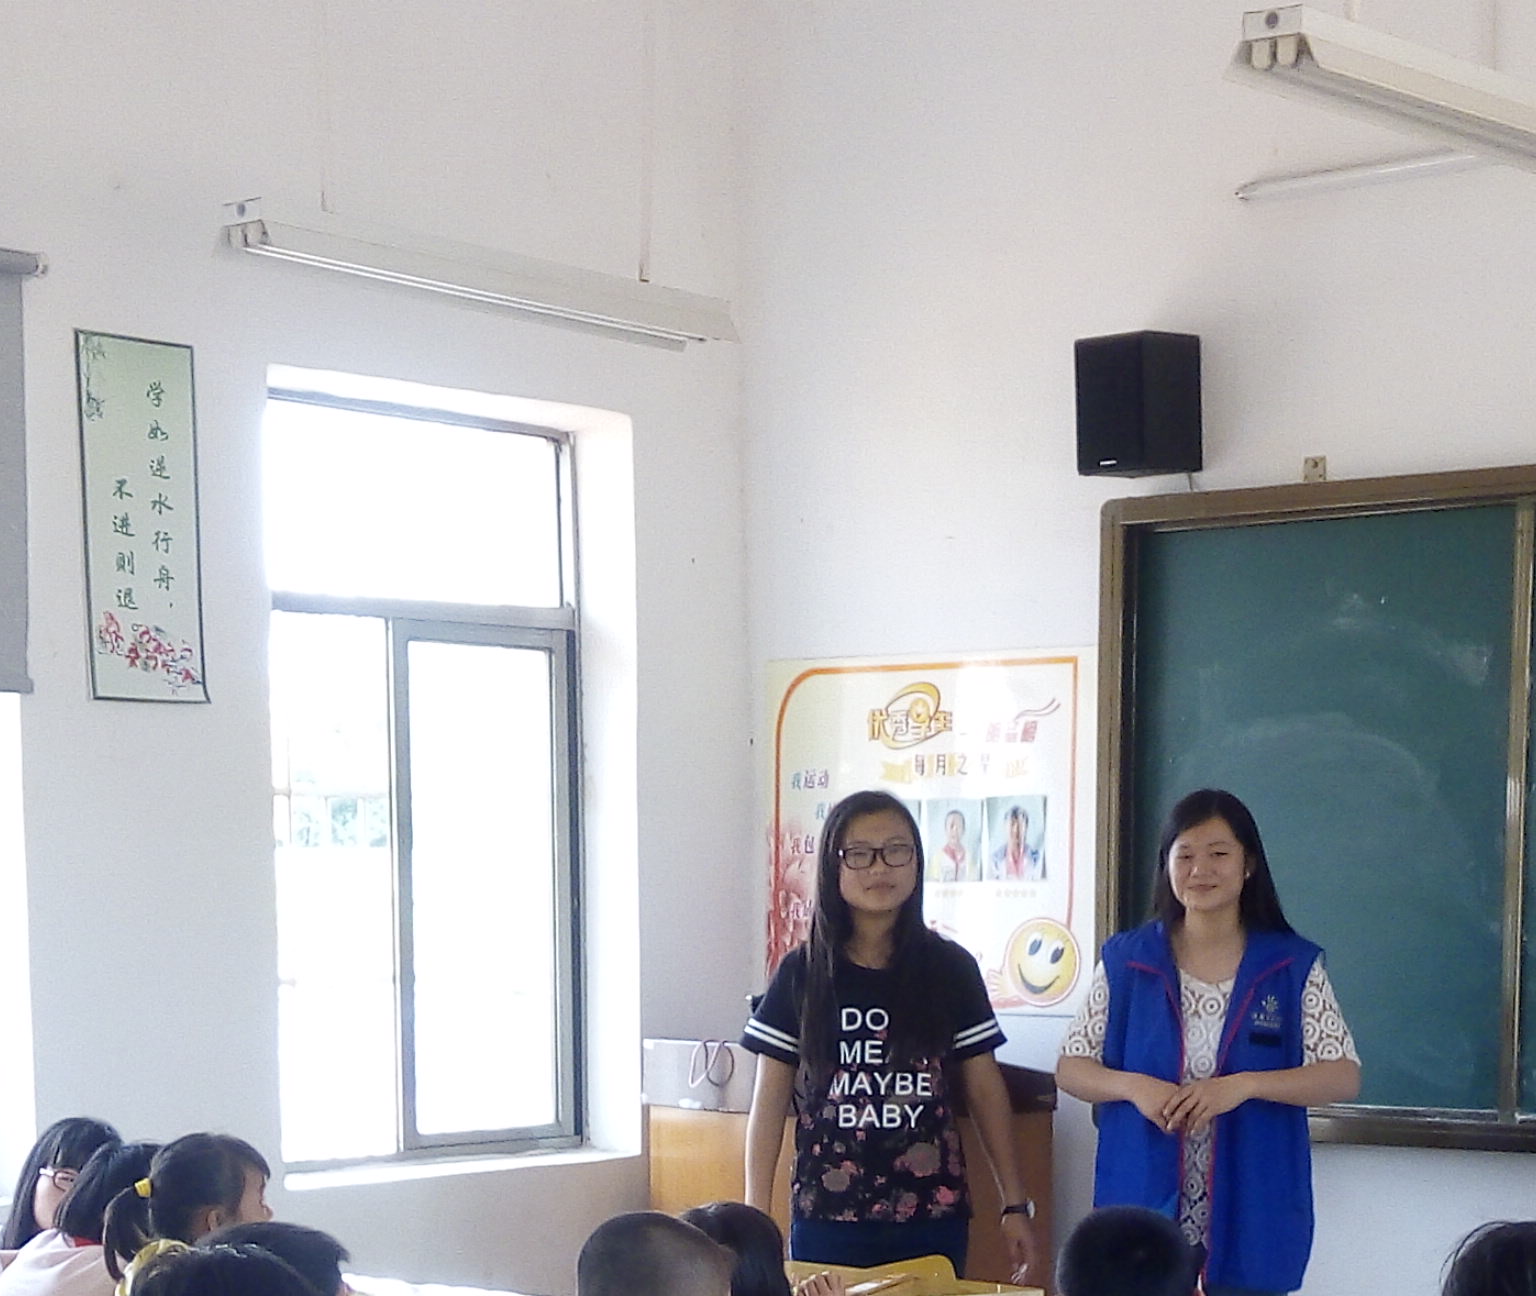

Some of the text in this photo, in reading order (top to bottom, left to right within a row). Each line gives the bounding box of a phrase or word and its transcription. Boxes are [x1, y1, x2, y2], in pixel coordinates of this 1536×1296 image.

[111, 478, 139, 611] 不进则退
[840, 1007, 890, 1032] DO
[839, 1040, 884, 1065] ME
[829, 1071, 933, 1097] MAYBE
[837, 1103, 925, 1129] BABY
